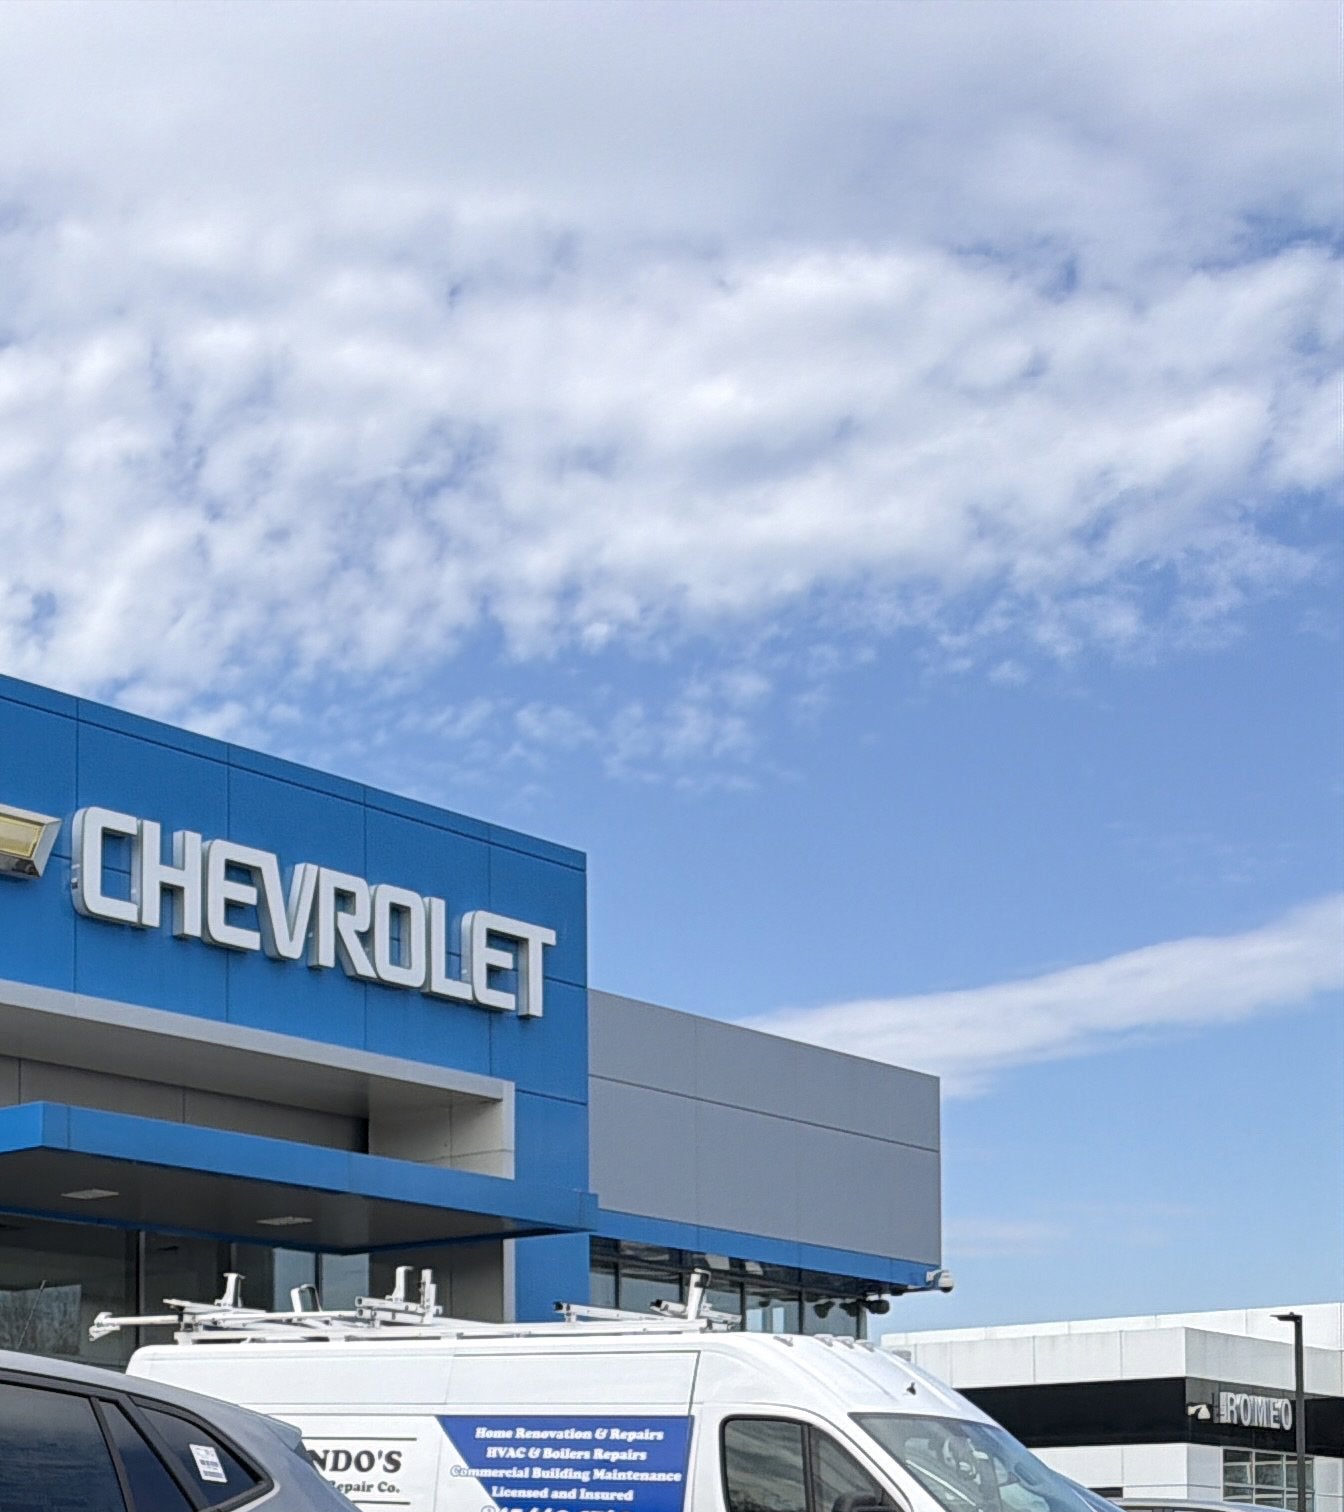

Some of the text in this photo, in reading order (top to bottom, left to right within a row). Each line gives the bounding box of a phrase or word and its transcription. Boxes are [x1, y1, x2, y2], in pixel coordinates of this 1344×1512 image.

[71, 806, 557, 1019] CHEVROLET
[1220, 1391, 1293, 1431] ROMEO
[474, 1426, 665, 1443] Home Renovation & Repairs
[486, 1446, 648, 1462] HVAC & Boilers Repairs
[450, 1465, 682, 1482] Commercial Building Maintenance
[377, 1481, 401, 1494] Co.
[491, 1485, 634, 1502] Licensed and Insured
